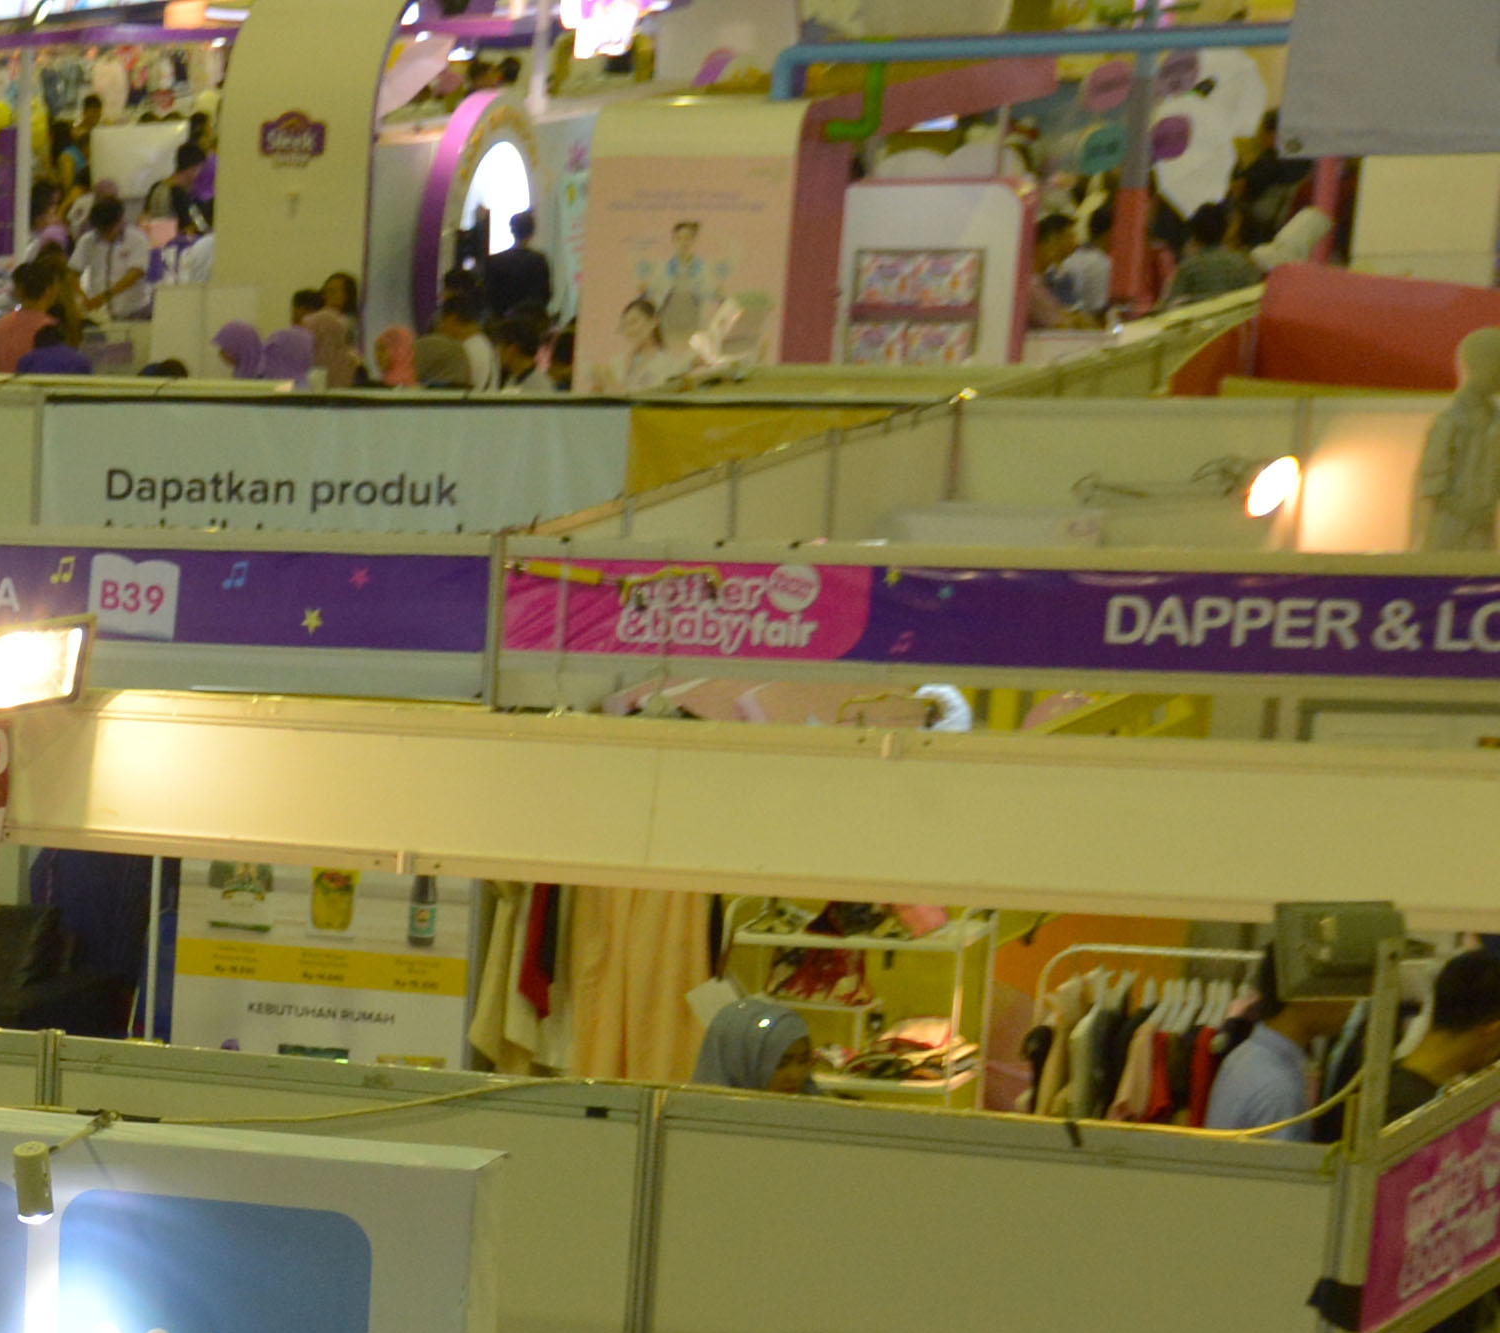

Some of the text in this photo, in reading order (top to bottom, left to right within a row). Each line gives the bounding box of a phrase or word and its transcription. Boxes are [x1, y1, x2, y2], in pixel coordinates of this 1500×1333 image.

[107, 469, 458, 515] Dapatkan produk
[100, 580, 165, 615] B39
[743, 613, 819, 649] fair
[1105, 597, 1362, 651] DAPPER
[1371, 599, 1421, 652] &
